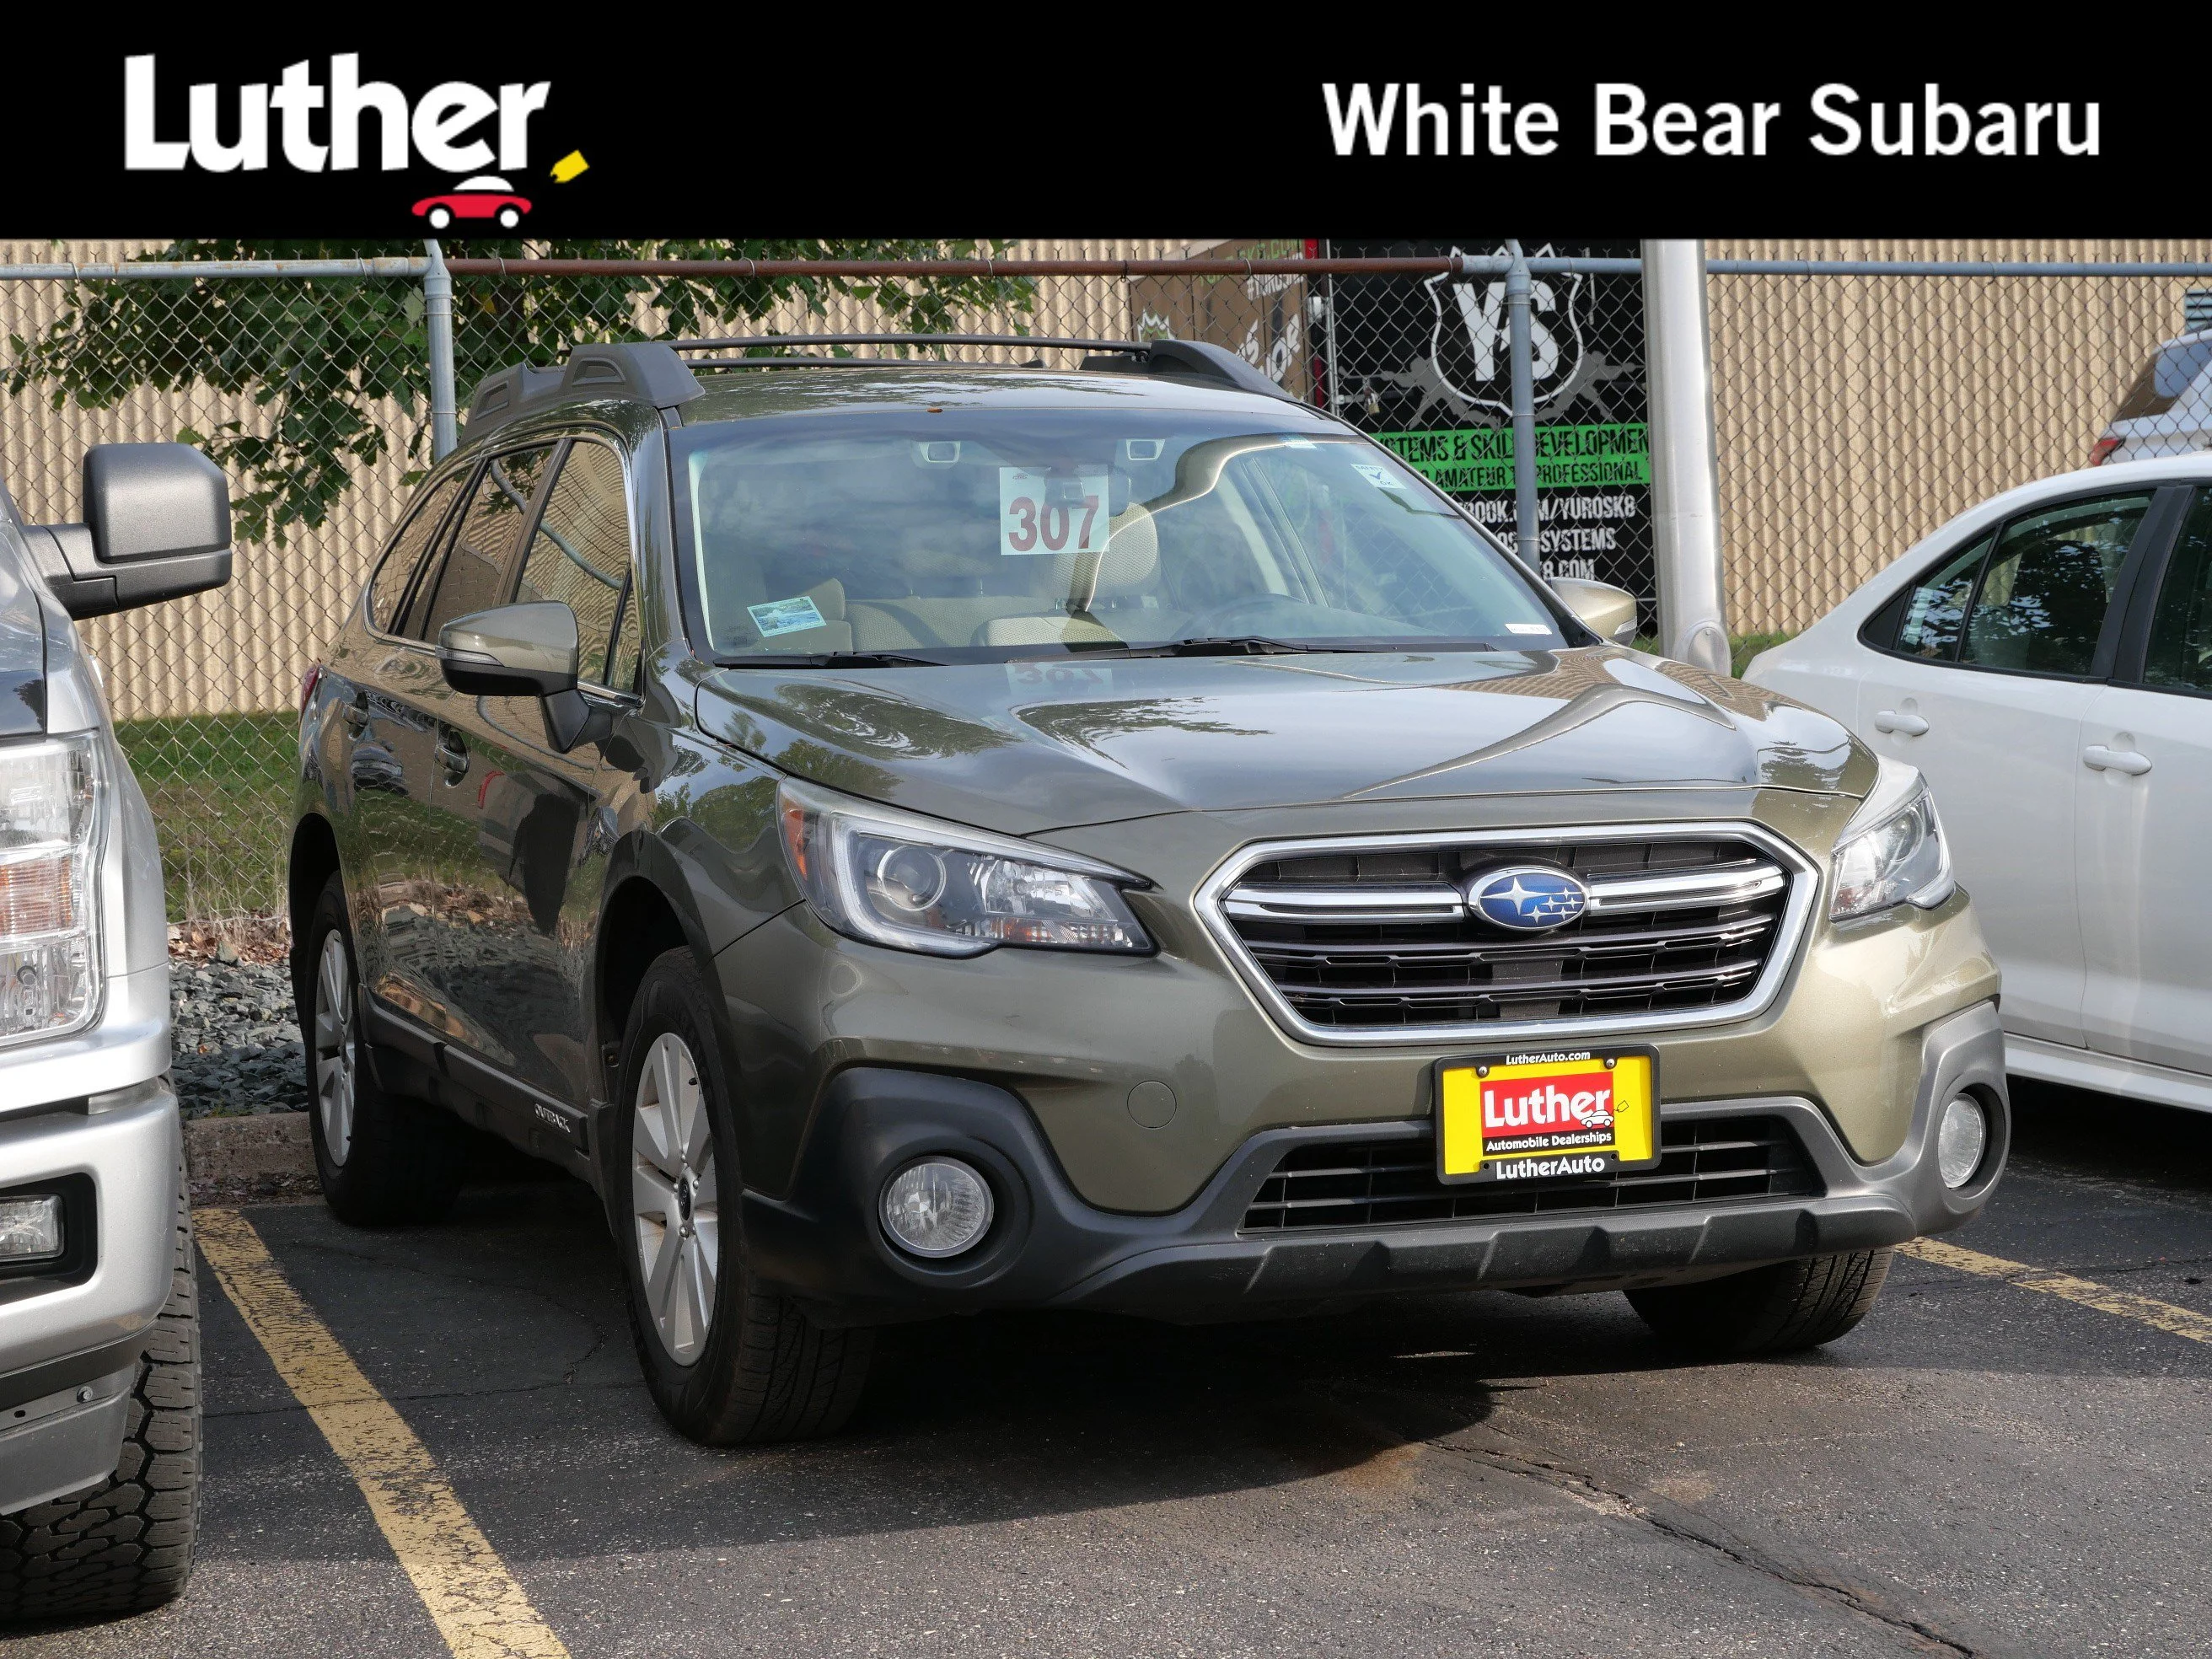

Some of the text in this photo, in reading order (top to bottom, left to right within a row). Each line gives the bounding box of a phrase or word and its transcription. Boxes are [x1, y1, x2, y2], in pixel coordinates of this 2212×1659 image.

[1453, 434, 1467, 461] &
[1470, 431, 1514, 460] SKIL
[1535, 427, 1650, 458] EVELOPMEN
[1435, 466, 1506, 489] AMATEUR
[1008, 495, 1099, 552] 307
[1506, 1051, 1591, 1066] LutherAuto.com
[1484, 1084, 1611, 1129] Luther
[1486, 1131, 1612, 1152] Automobile Dealerships
[1495, 1156, 1605, 1180] LutherAuto
